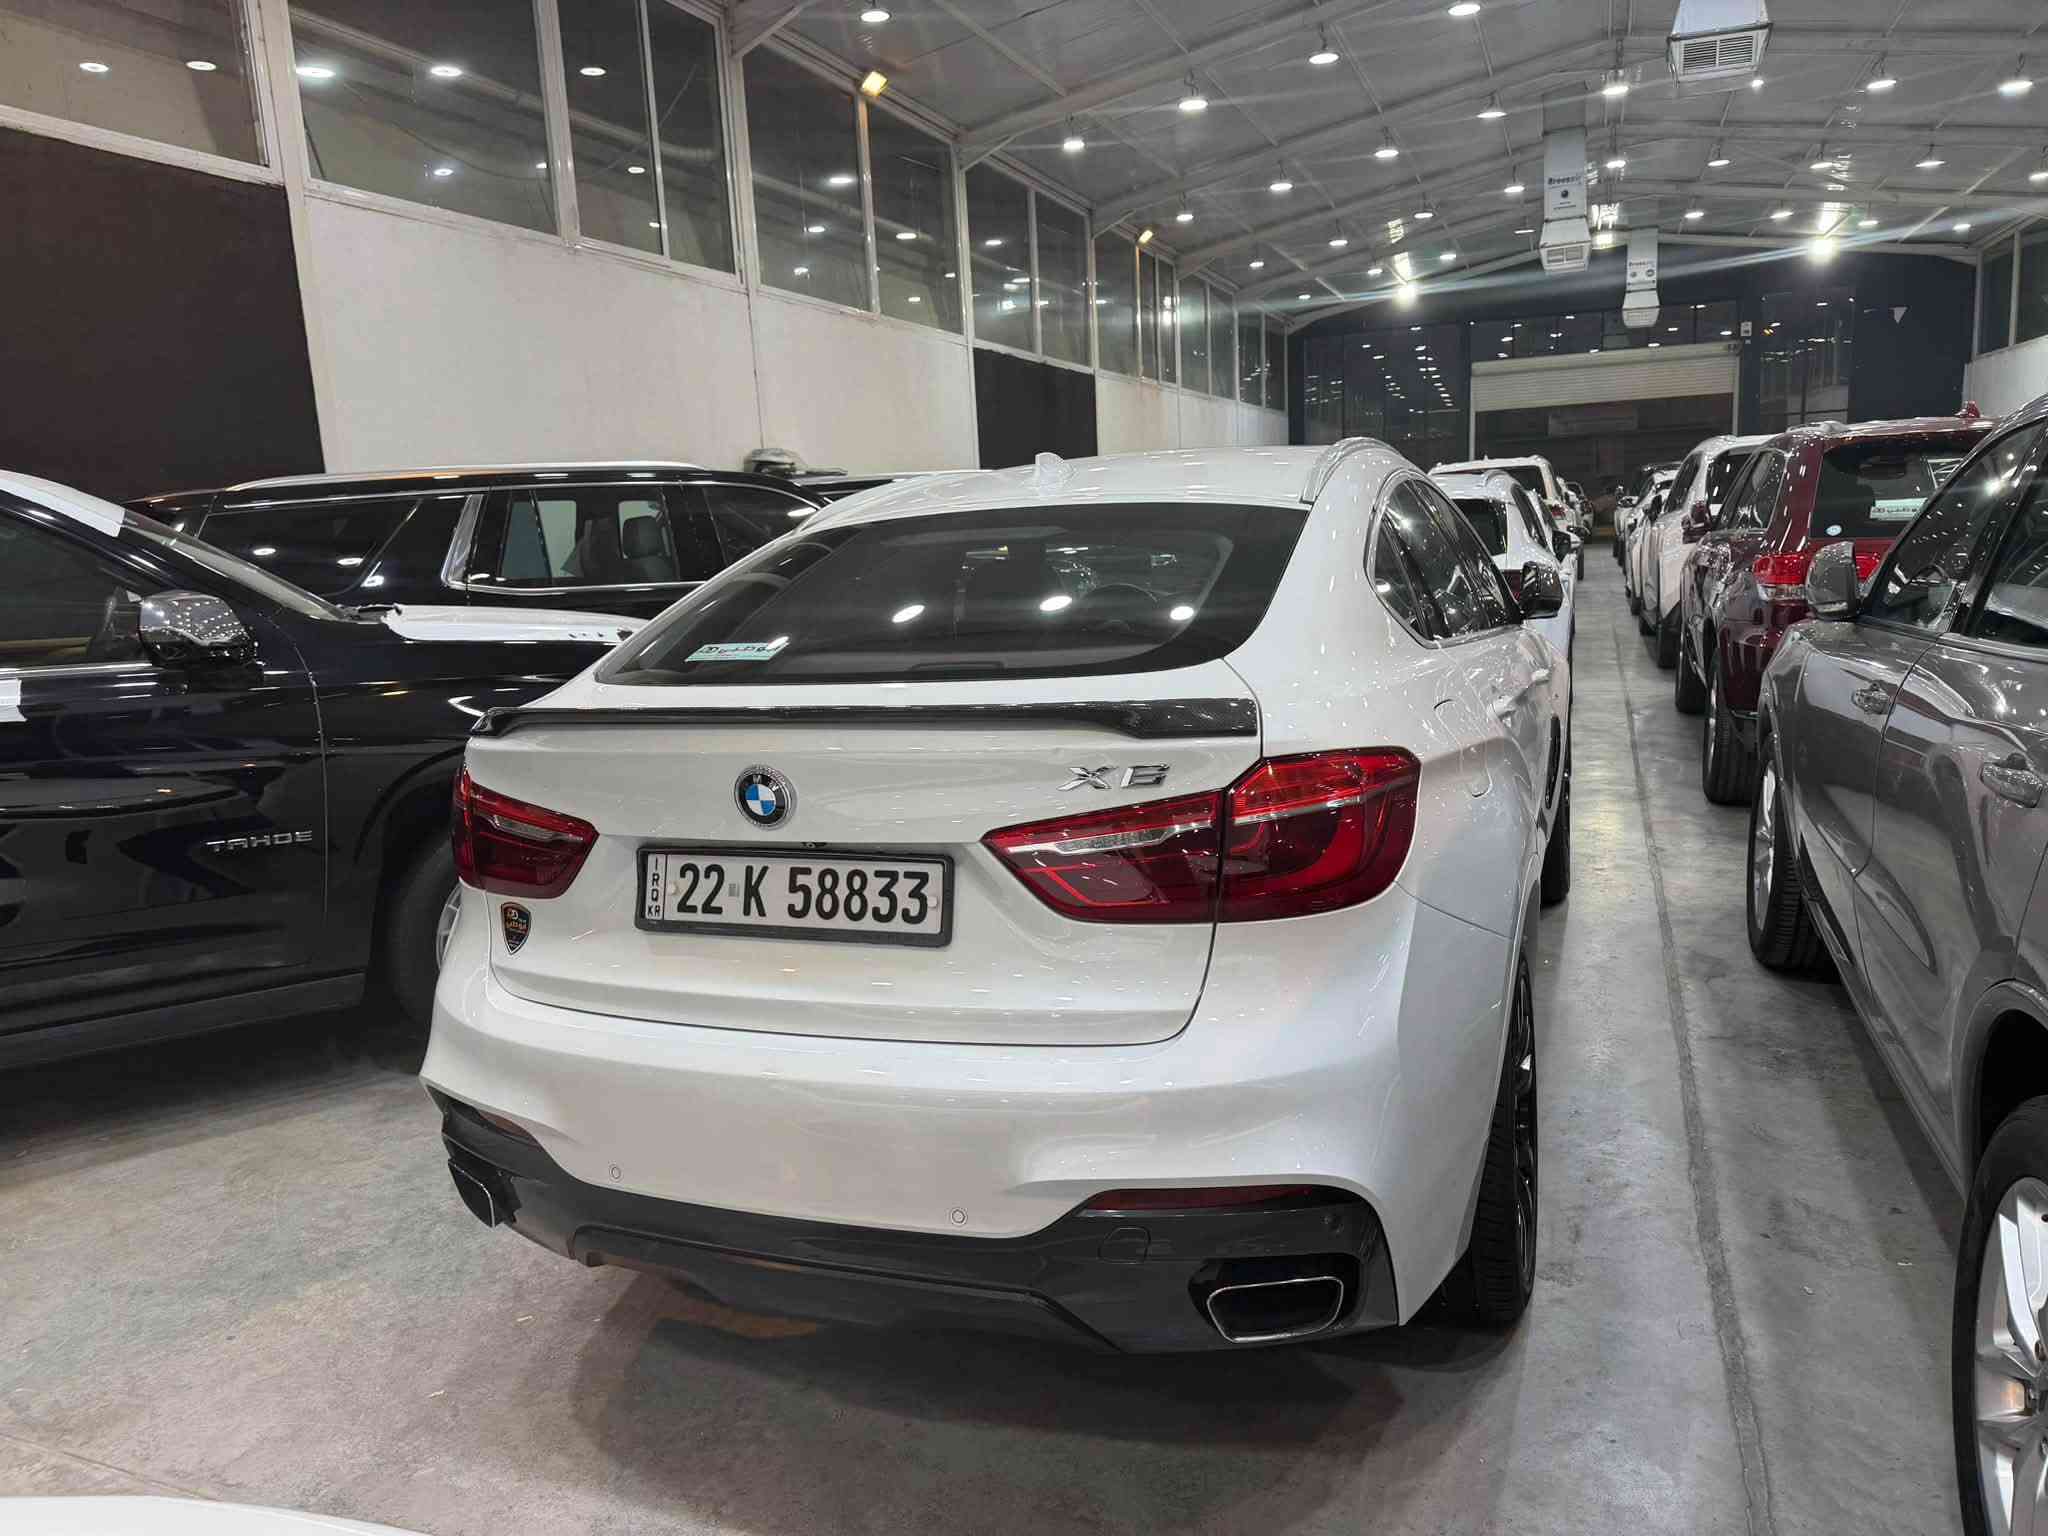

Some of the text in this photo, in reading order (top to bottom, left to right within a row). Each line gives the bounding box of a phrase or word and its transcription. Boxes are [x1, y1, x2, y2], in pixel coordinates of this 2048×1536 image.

[205, 830, 312, 852] TAHOE
[677, 863, 930, 925] 22 K 58833
